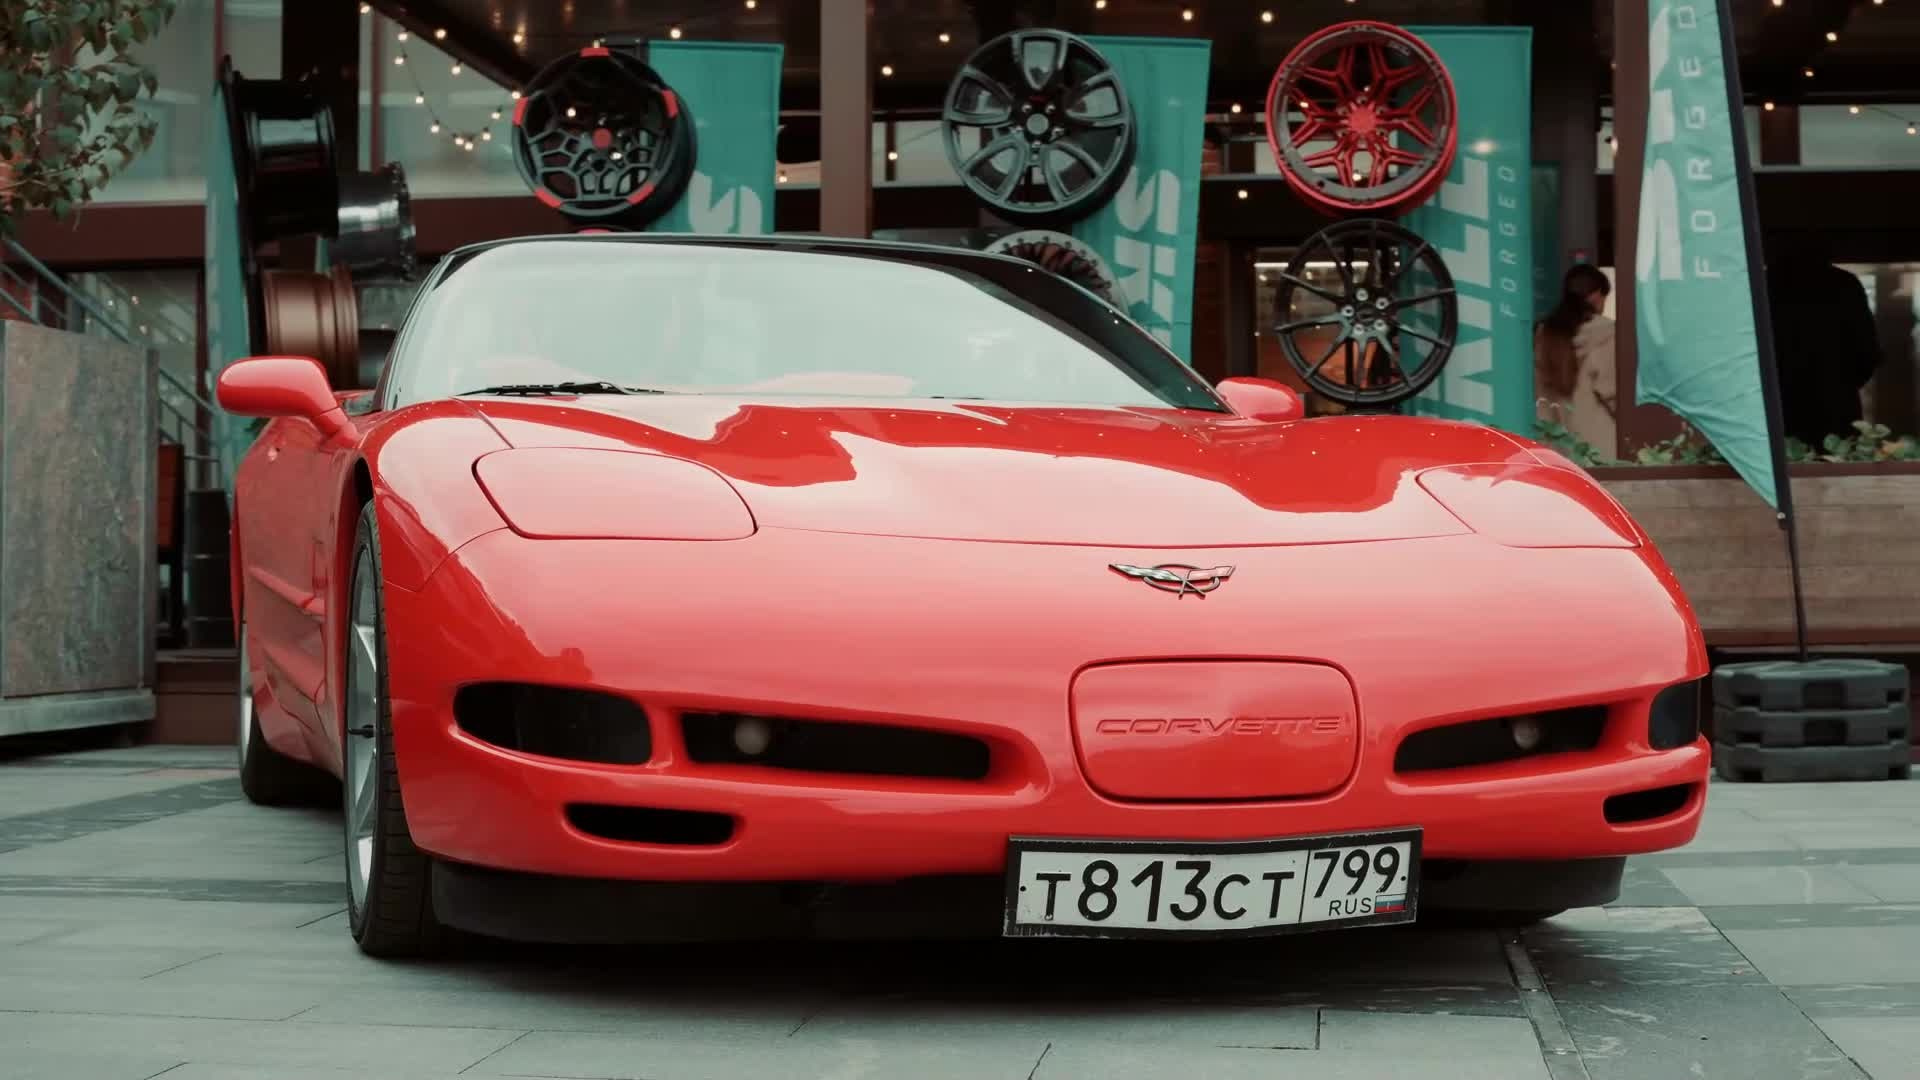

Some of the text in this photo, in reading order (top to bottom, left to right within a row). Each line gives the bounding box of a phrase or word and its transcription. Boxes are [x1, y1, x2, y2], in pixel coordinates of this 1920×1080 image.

[1677, 6, 1721, 279] FORGED
[1412, 157, 1494, 424] KILL
[1498, 166, 1521, 319] FORGED
[1096, 716, 1343, 735] CORVETTE
[1313, 846, 1400, 899] 799
[1328, 896, 1372, 917] RUS
